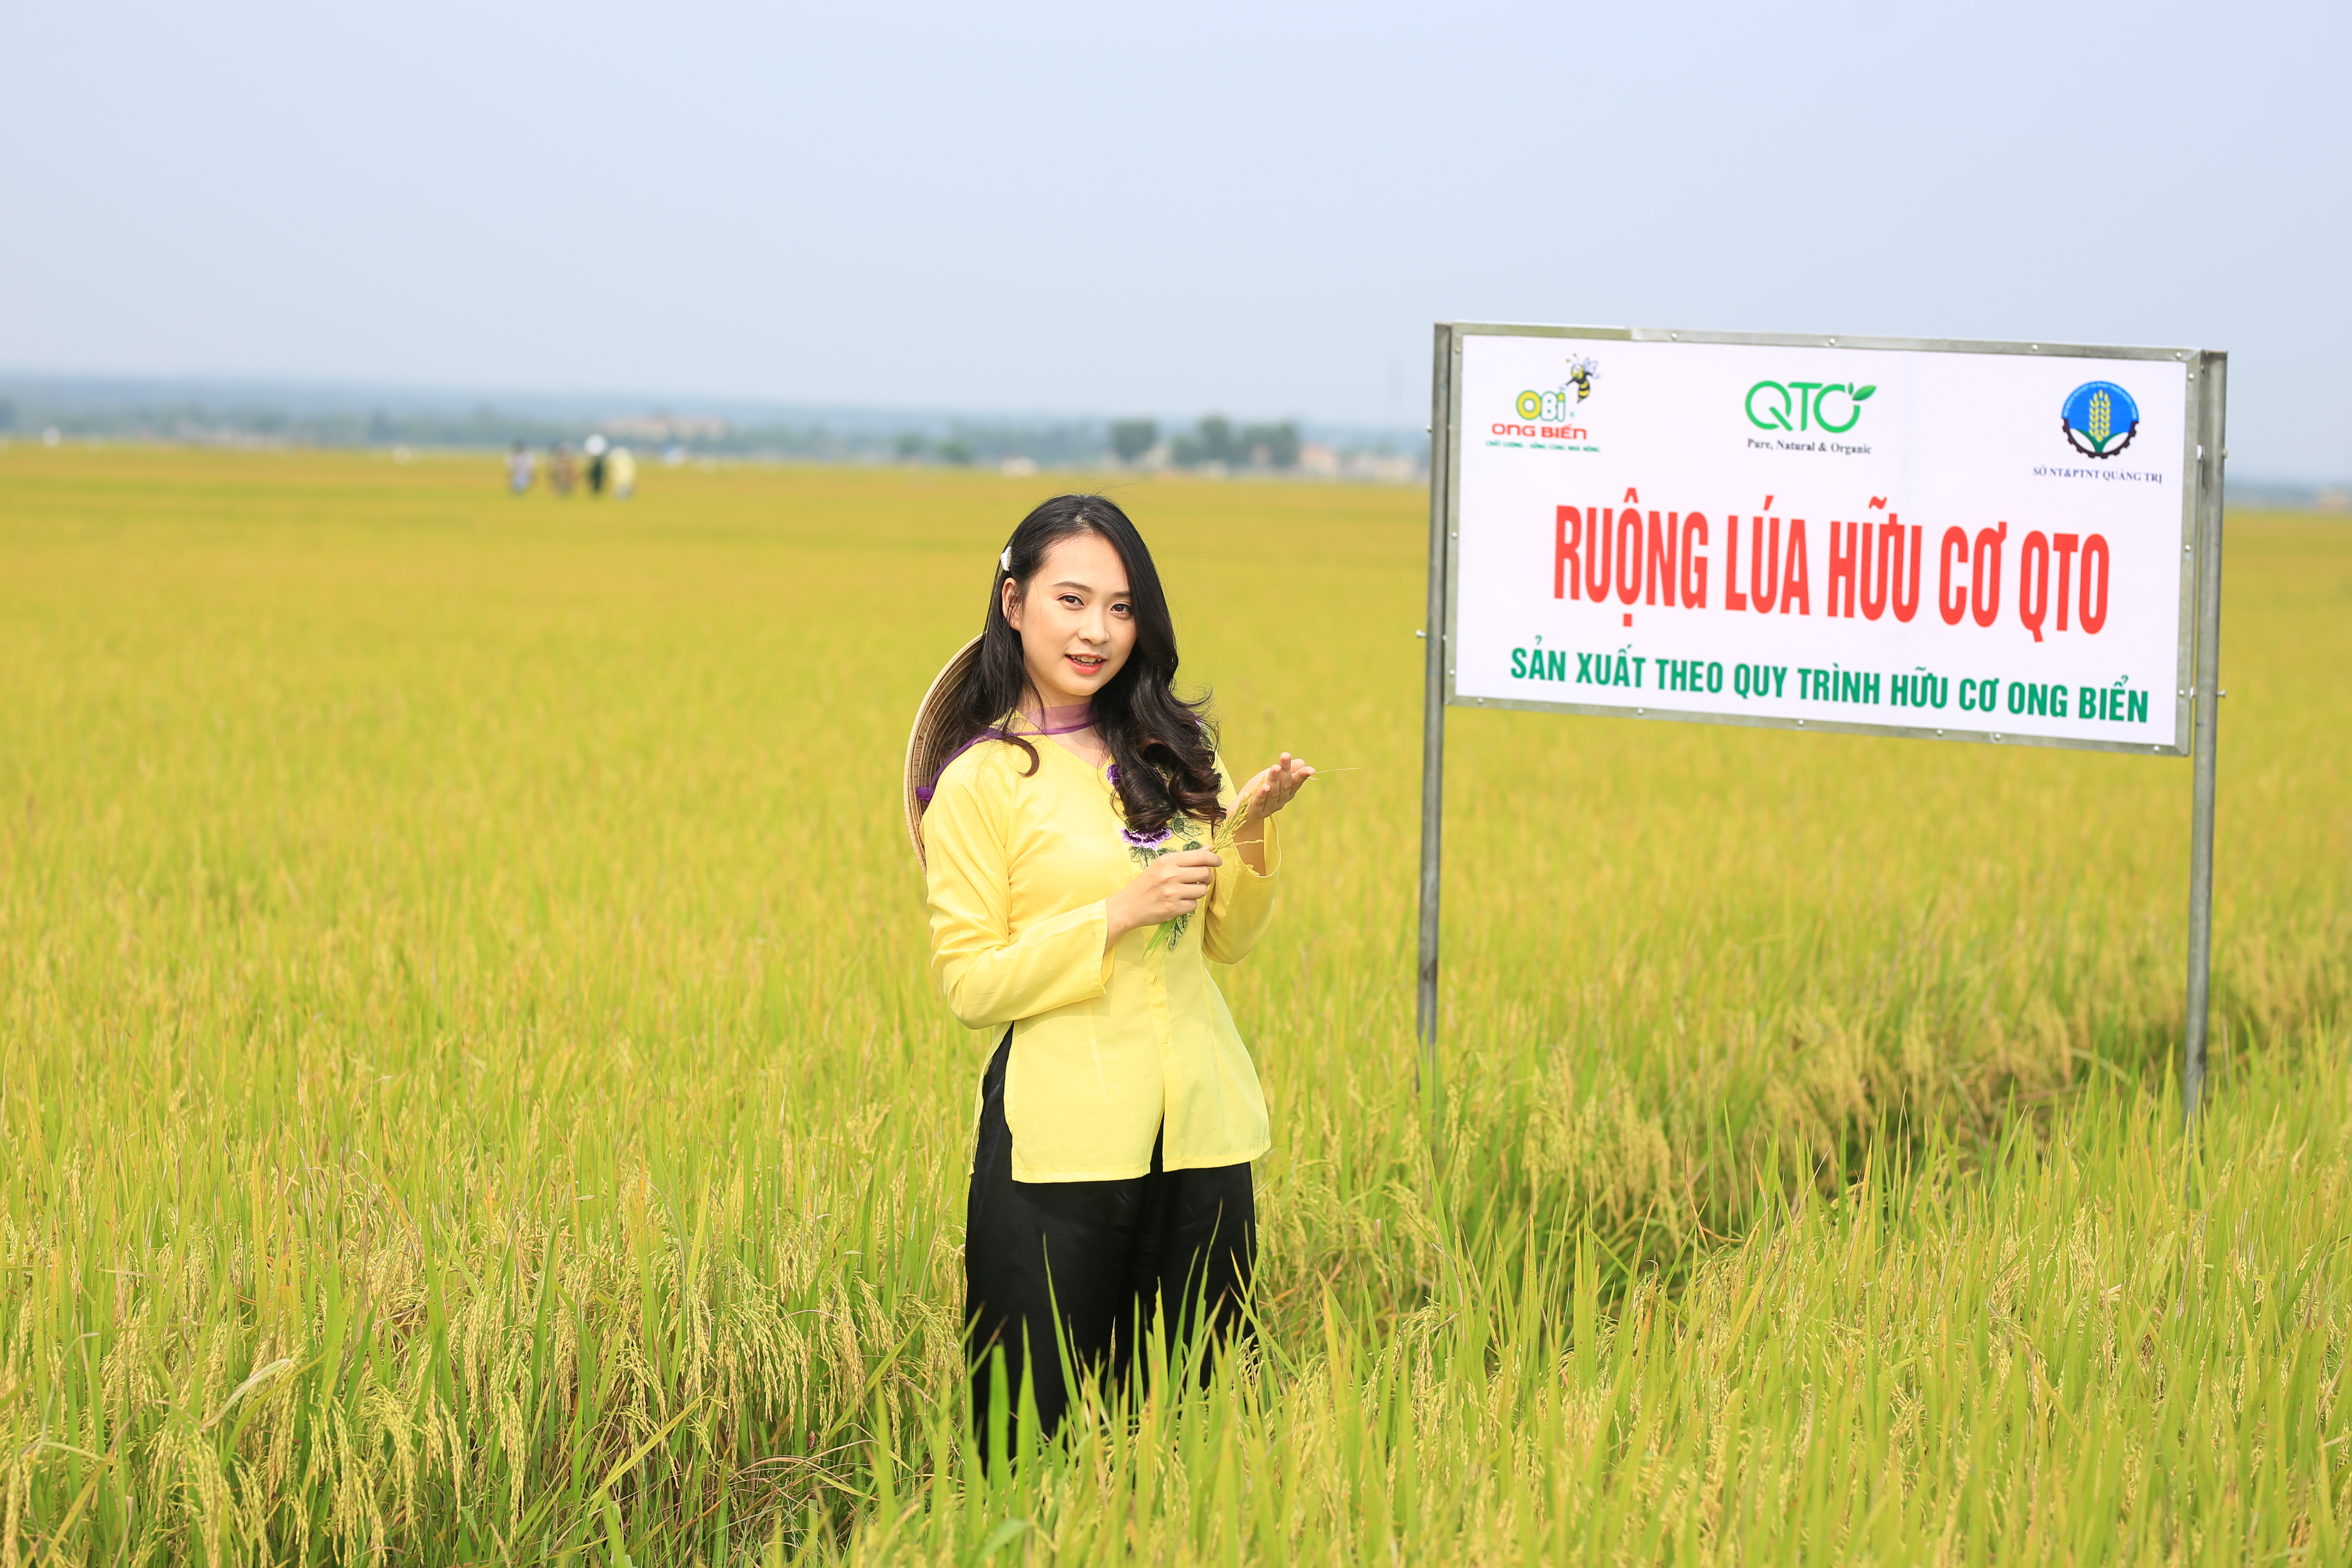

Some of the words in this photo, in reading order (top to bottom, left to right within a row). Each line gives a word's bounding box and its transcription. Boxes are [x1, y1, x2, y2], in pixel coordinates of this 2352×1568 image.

[1492, 423, 1536, 437] ONG
[1745, 380, 1861, 433] QTO
[1748, 438, 1773, 450] Pure,
[1777, 440, 1815, 451] Natural
[1818, 442, 1826, 452] &
[1831, 443, 1871, 455] Organic
[1554, 487, 1709, 628] RUỘNG
[1725, 495, 1810, 616] LÚA
[1827, 496, 1923, 623] HỮU
[1939, 521, 2007, 628] CƠ
[2019, 530, 2110, 643] QTO
[1511, 635, 1566, 682] SẢN
[1576, 645, 1646, 688] XUẤT
[1656, 659, 1723, 693] THEO
[1734, 664, 1788, 699] QUY
[1798, 663, 1880, 704] TRÌNH
[1891, 667, 1948, 709] HỮU
[1960, 678, 2000, 712] CƠ
[2008, 682, 2068, 717] ONG
[2079, 675, 2149, 723] BIỂN
